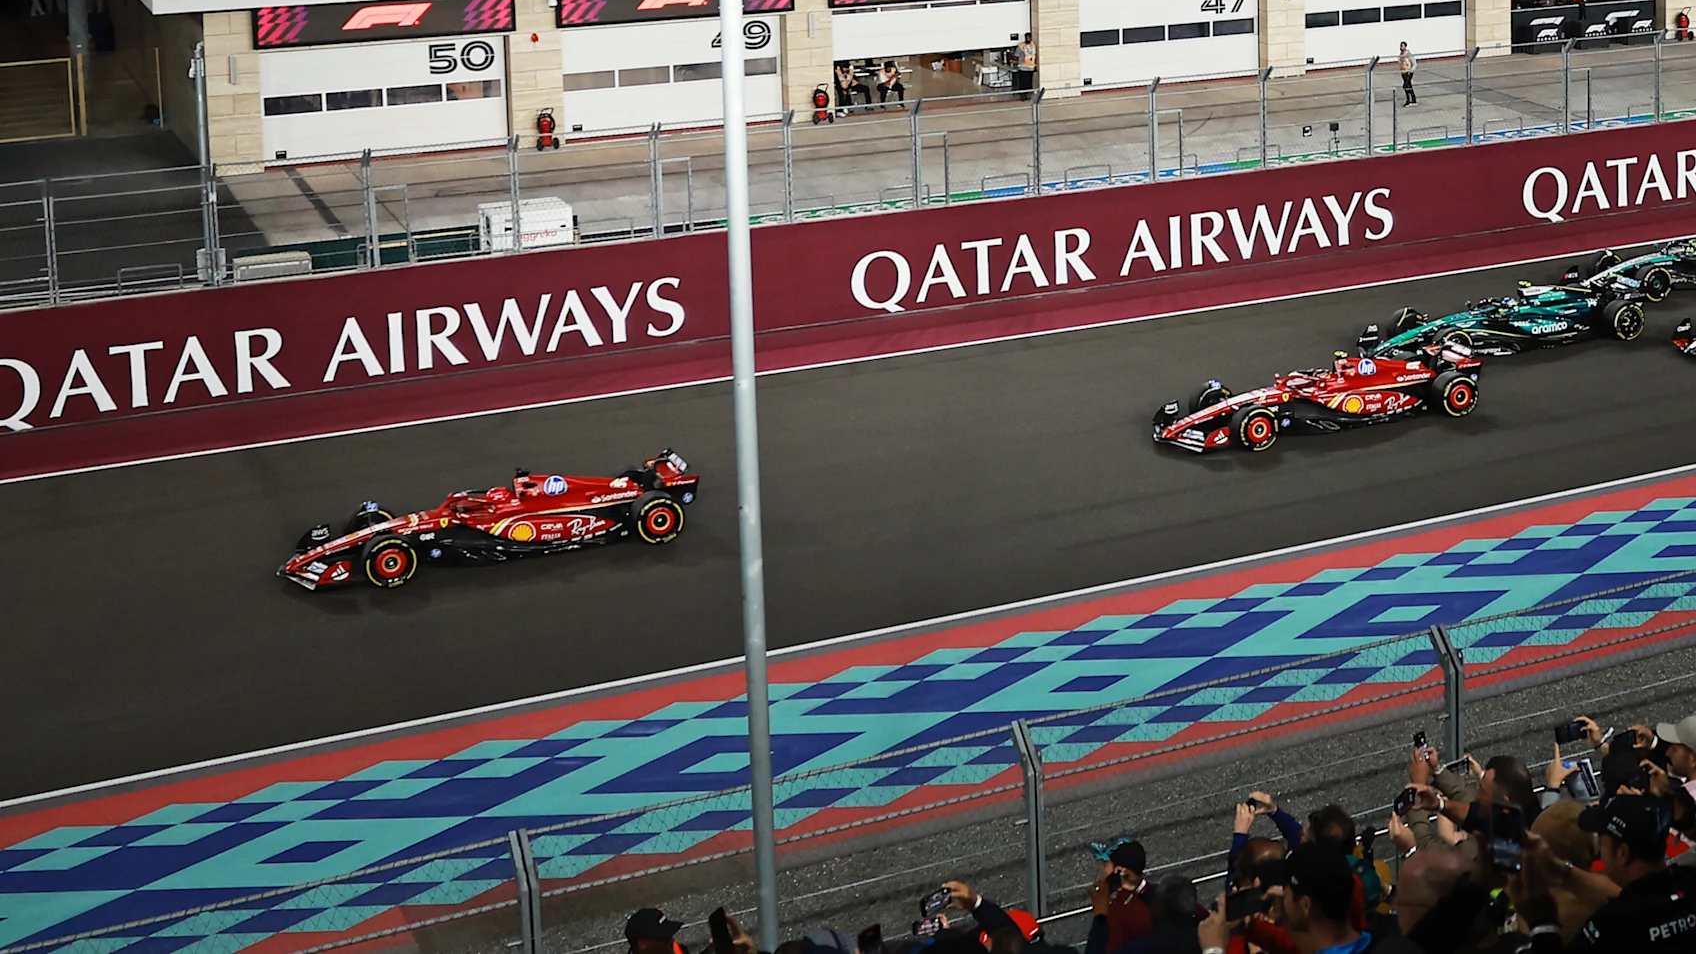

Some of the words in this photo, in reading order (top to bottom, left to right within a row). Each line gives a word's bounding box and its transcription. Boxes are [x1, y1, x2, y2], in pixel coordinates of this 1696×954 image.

[341, 2, 432, 31] F1
[428, 40, 495, 75] 50
[850, 227, 1097, 314] QATAR
[1119, 187, 1395, 277] AIRWAYS
[322, 276, 687, 383] AIRWAYS
[1532, 321, 1567, 335] aramco
[1360, 361, 1374, 376] hp
[549, 478, 563, 495] hp
[601, 490, 637, 501] Santander
[311, 527, 329, 537] aws
